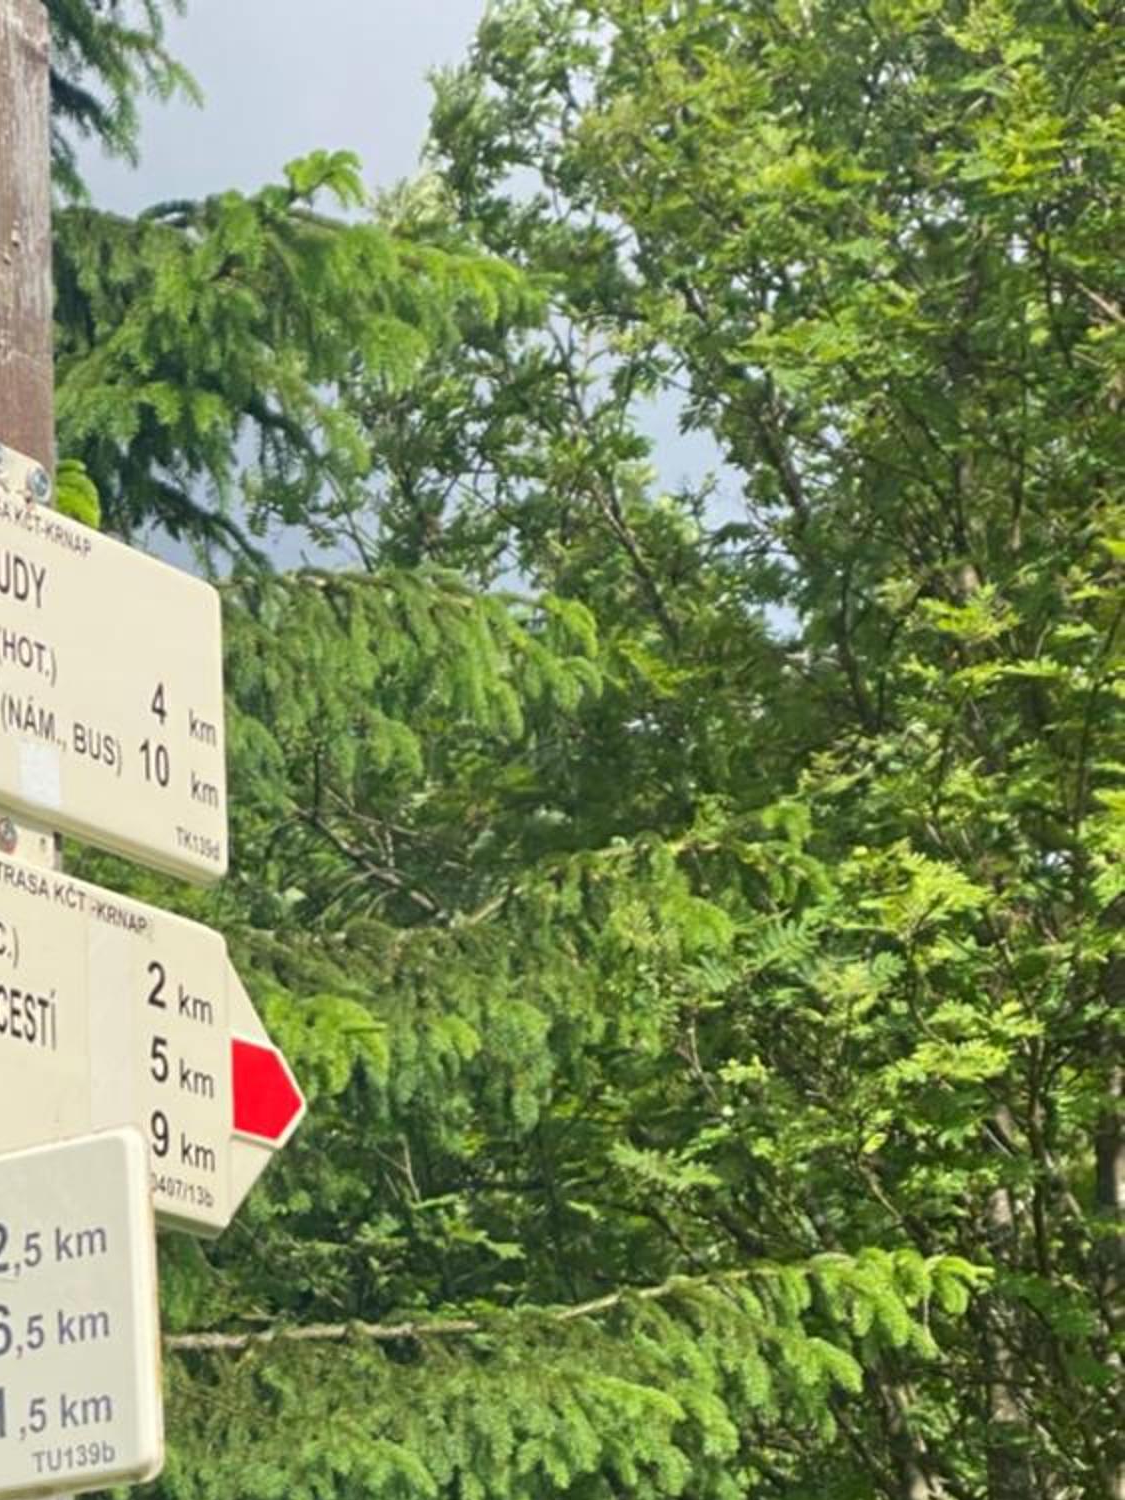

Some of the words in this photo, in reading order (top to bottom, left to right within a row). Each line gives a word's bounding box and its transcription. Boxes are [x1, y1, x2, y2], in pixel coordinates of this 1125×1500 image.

[151, 681, 167, 726] 4
[188, 707, 217, 747] km
[73, 721, 123, 778] BUS)
[139, 738, 170, 788] 10
[190, 770, 219, 808] km
[53, 881, 86, 912] KČT
[147, 960, 167, 1010] 2
[178, 984, 213, 1025] km
[150, 1035, 169, 1084] 5
[179, 1057, 215, 1099] km
[150, 1109, 170, 1158] 9
[181, 1132, 216, 1173] km
[55, 1226, 107, 1262] km
[57, 1309, 110, 1344] km
[60, 1393, 113, 1428] km
[31, 1440, 116, 1473] TU139b
